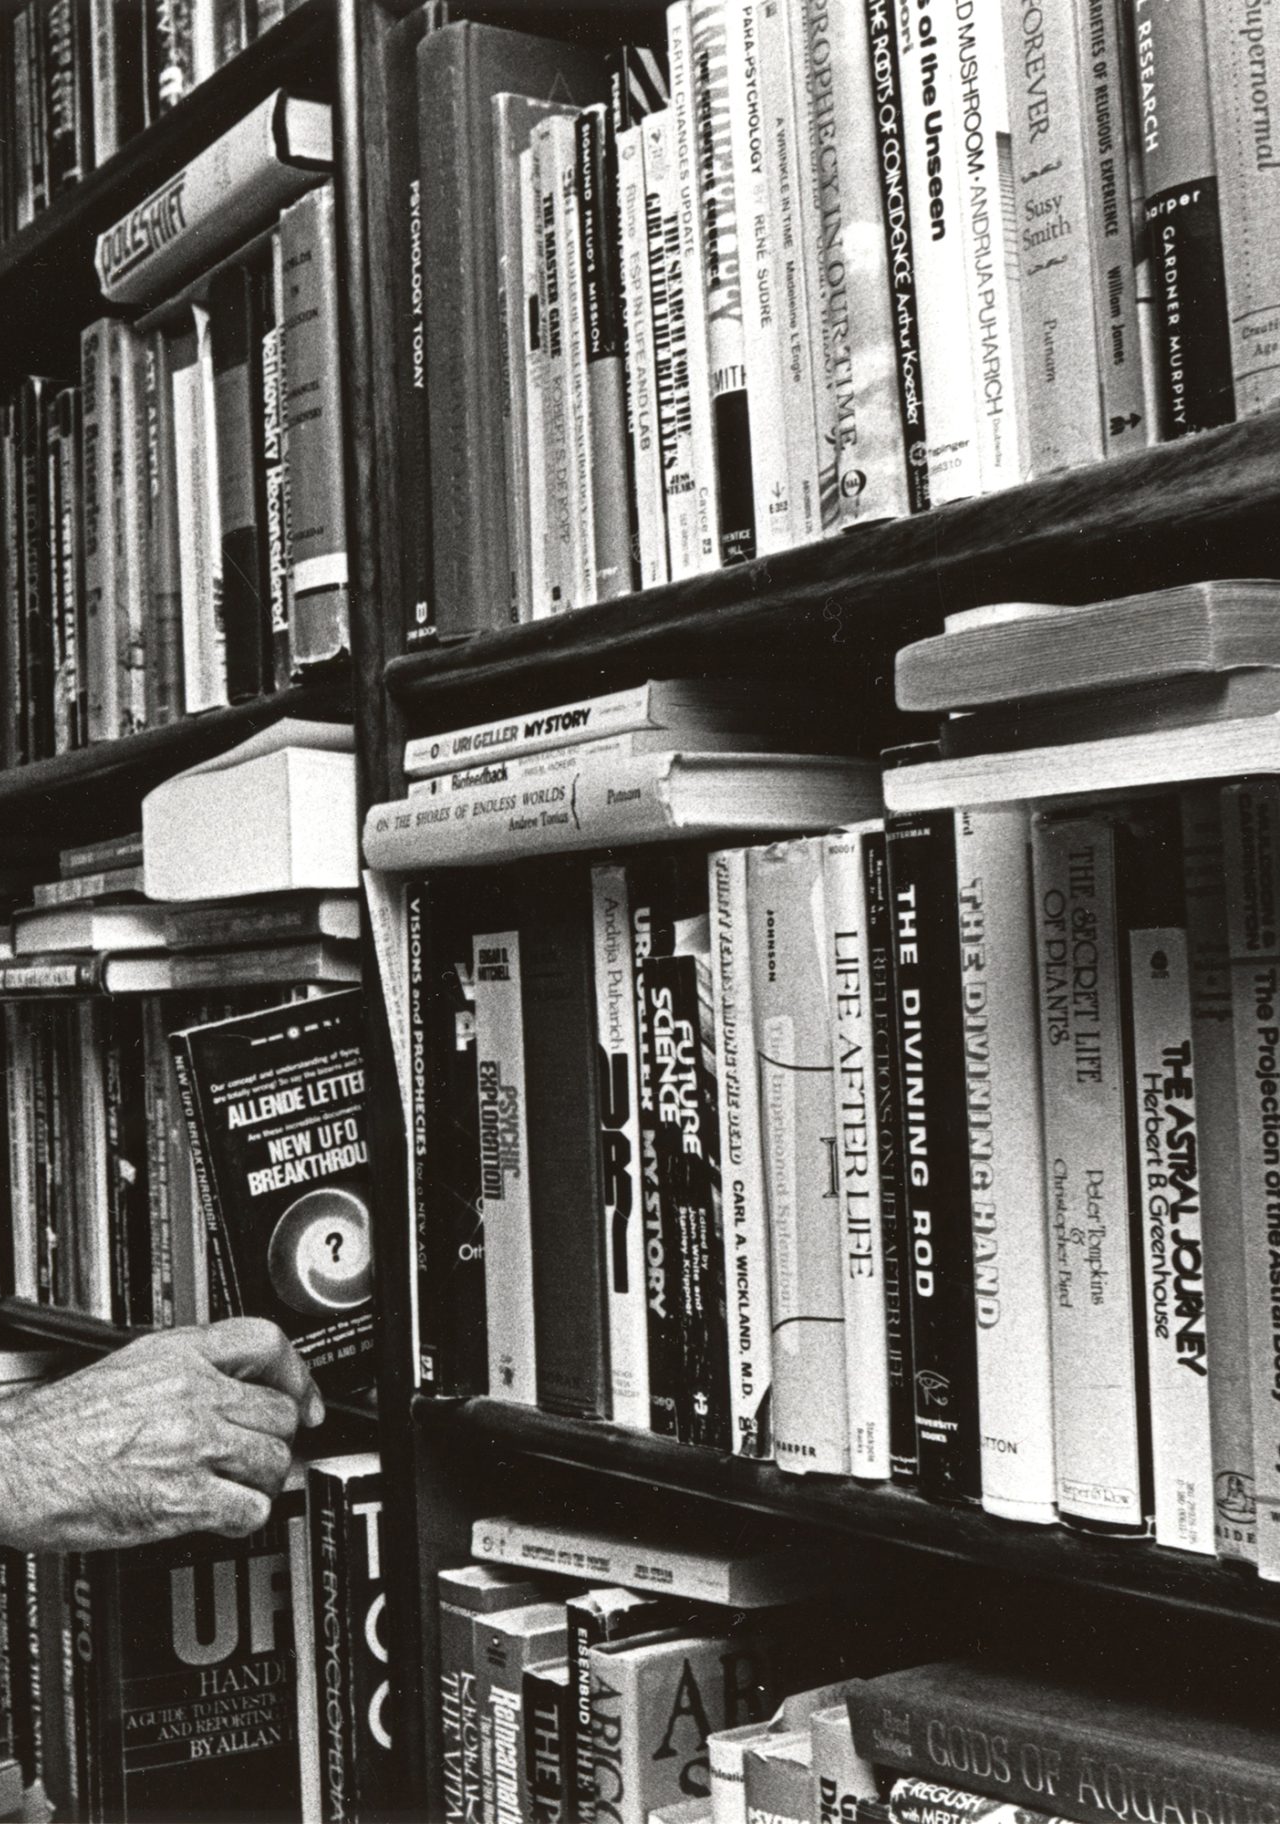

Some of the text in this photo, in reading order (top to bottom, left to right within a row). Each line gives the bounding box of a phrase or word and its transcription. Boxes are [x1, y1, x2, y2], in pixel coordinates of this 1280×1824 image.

[1020, 0, 1050, 144] OREVER
[1137, 19, 1159, 153] RESEARCH
[672, 26, 694, 258] EARTH CHANGES UPDATE
[742, 5, 772, 329] PARA-PSYCHOLOGY SUDRE
[777, 130, 790, 194] WRINKLE
[918, 15, 946, 242] of the Unseen
[581, 124, 593, 200] SIGMUND
[588, 282, 599, 353] MISSION
[781, 198, 791, 213] IN
[782, 216, 794, 248] TIME
[823, 204, 843, 252] IN
[872, 35, 923, 425] ROOTS OF COINCIDENCE Arthur Koestler
[957, 22, 1004, 417] MUSHROOM ANDRIJA PUHARICH
[1022, 213, 1072, 251] Smith
[1024, 194, 1063, 221] Susy
[1092, 61, 1125, 366] OF RELIGIOUS EXPERIENCE William James
[409, 180, 426, 388] PSYCHOLOGY TODAY
[543, 192, 562, 358] THE MASTER GAME
[630, 250, 641, 290] ESP
[633, 296, 643, 316] IN
[828, 259, 849, 344] OUR
[646, 192, 678, 470] GIRL WITH EYES
[663, 214, 692, 437] THE SEARCH FOR THE
[1043, 318, 1057, 383] Putnam
[1162, 225, 1186, 424] GARDNER MURPHY
[636, 366, 650, 414] AND
[639, 417, 652, 451] LAB
[833, 345, 857, 448] TIME
[266, 464, 289, 633] Reconsidered
[452, 737, 473, 755] URI
[473, 725, 519, 750] GELLER
[546, 708, 591, 734] STORY
[376, 785, 566, 833] ON THE SHORES OF ENDLESS WORLDS
[607, 786, 642, 805] Putnam
[410, 898, 423, 983] VISIONS
[604, 897, 624, 1050] Andrija Puharich
[766, 909, 776, 982] JOHNSON
[1042, 888, 1070, 1047] OF PLANTS
[1069, 845, 1103, 1084] THE SECRET LIFE
[412, 990, 424, 1025] and
[1254, 968, 1277, 1021] The
[210, 1051, 339, 1093] Our concept and understanding of
[303, 1069, 317, 1079] the
[413, 1030, 427, 1155] PROPHECIES
[651, 987, 680, 1127] SCIENCE
[675, 1019, 703, 1159] FUTURE
[834, 931, 874, 1279] LIFE AFTER LIFE
[872, 948, 894, 1165] REFLECTIONS ON
[897, 884, 934, 1298] THE DIVINING ROD
[960, 876, 1000, 1330] THE DIVINING HAND
[1255, 1027, 1280, 1165] Projection
[174, 1055, 218, 1232] NEW UFO BREAKTHROUGH
[227, 1086, 306, 1130] ALLENDE
[247, 1127, 284, 1142] Are these
[268, 1118, 359, 1164] NEW UFO
[246, 1141, 368, 1196] BREAKTHROU
[732, 1179, 746, 1227] CARL
[1143, 1073, 1172, 1340] Herbert B. Greenhouse
[1162, 1039, 1208, 1377] THE ASTRAL JOURNEY
[325, 1232, 343, 1263] ?
[417, 1202, 426, 1236] NEW
[642, 1130, 666, 1319] MY STORY
[698, 1208, 709, 1271] Edited by
[735, 1233, 747, 1251] A.
[1052, 1158, 1074, 1308] Christopher Bird
[1083, 1168, 1110, 1306] Peter Tompkins
[740, 1362, 753, 1399] M.D.
[170, 1553, 289, 1666] UF
[138, 1703, 210, 1726] GUIDE TO
[321, 1509, 346, 1821] THE ENCYCLOPEDIA
[577, 1626, 591, 1725] EISENBUD
[157, 1722, 193, 1742] AND
[189, 1726, 282, 1759] BY ALLAN
[926, 1719, 1061, 1796] GODS OF
